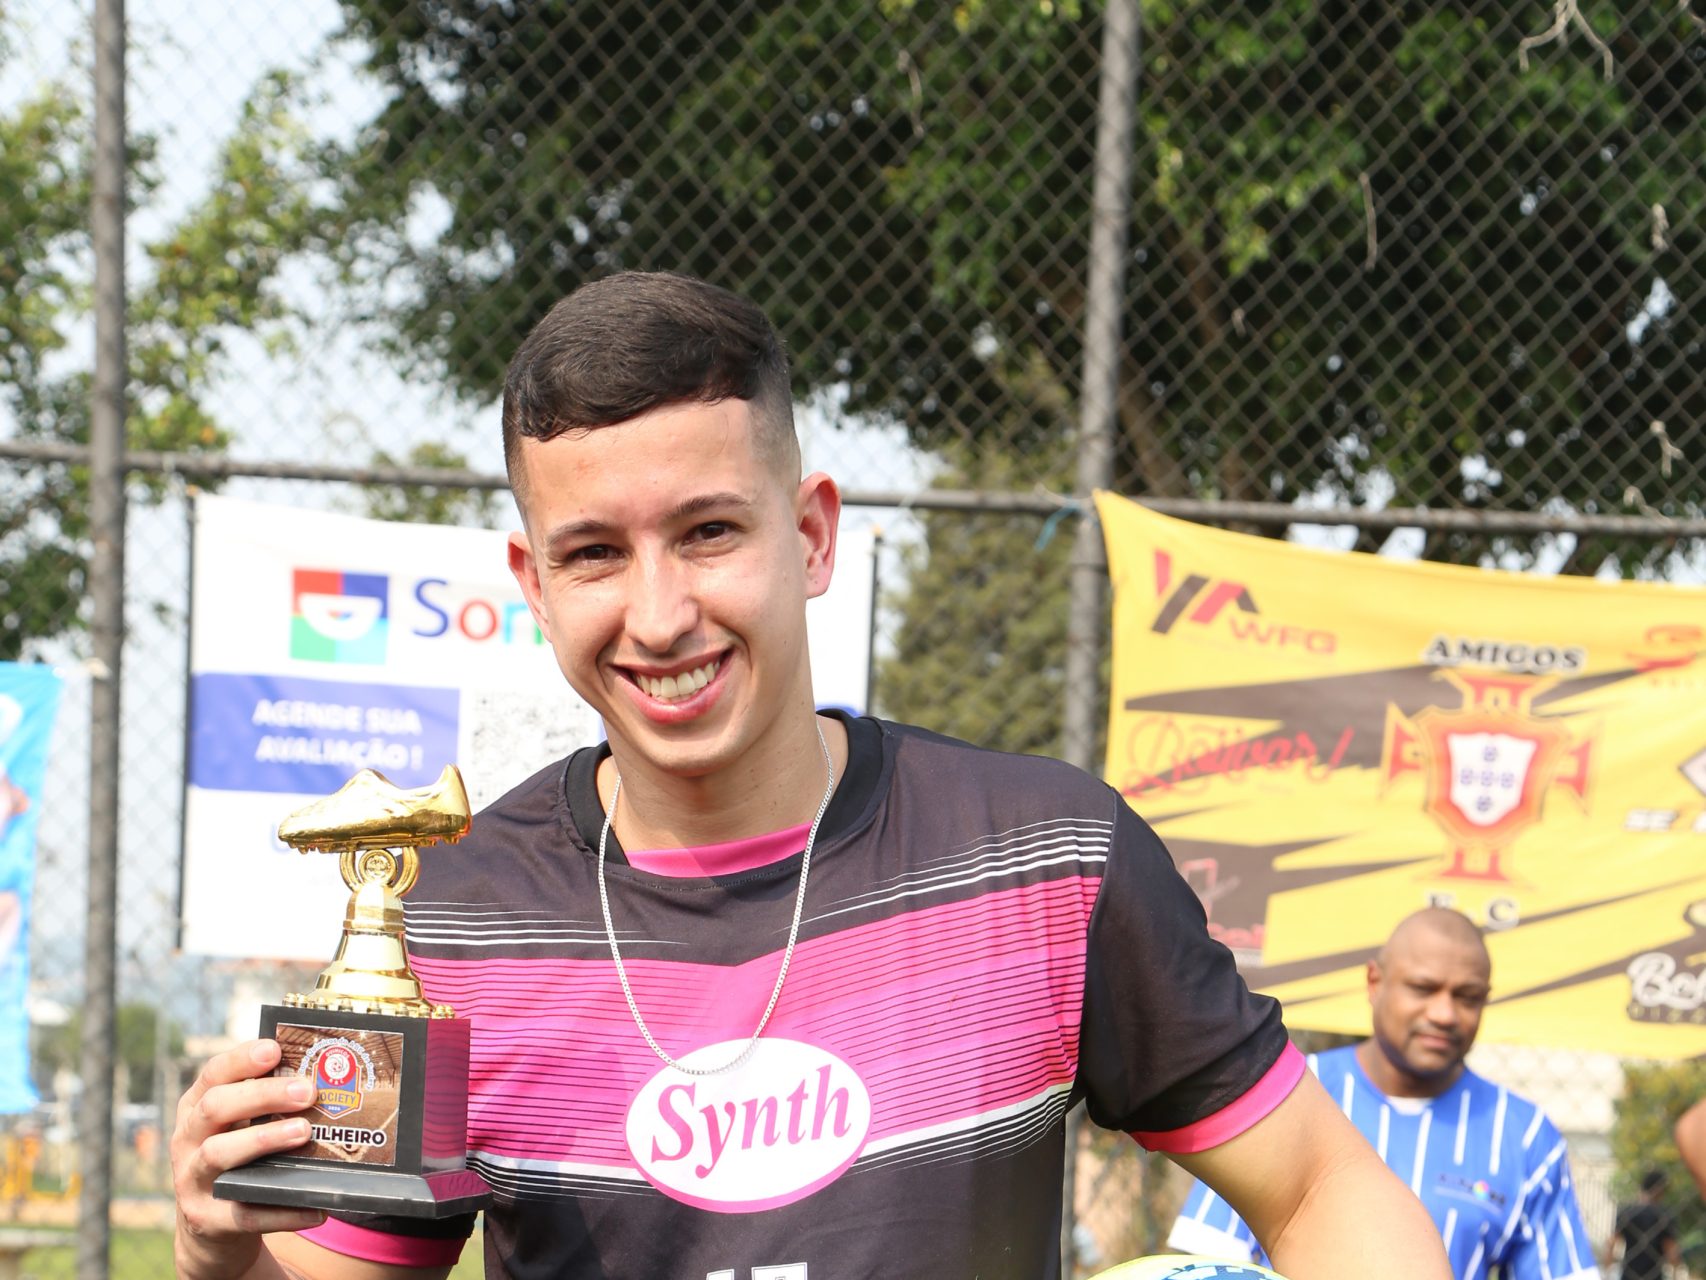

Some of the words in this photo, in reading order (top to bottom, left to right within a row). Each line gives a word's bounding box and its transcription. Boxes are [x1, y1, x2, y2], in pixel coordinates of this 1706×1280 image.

[1427, 636, 1583, 669] AMIGOS
[253, 699, 362, 731] AGENDE
[366, 707, 422, 734] SUA
[318, 1092, 356, 1104] OCIETY
[651, 1064, 852, 1179] Synth
